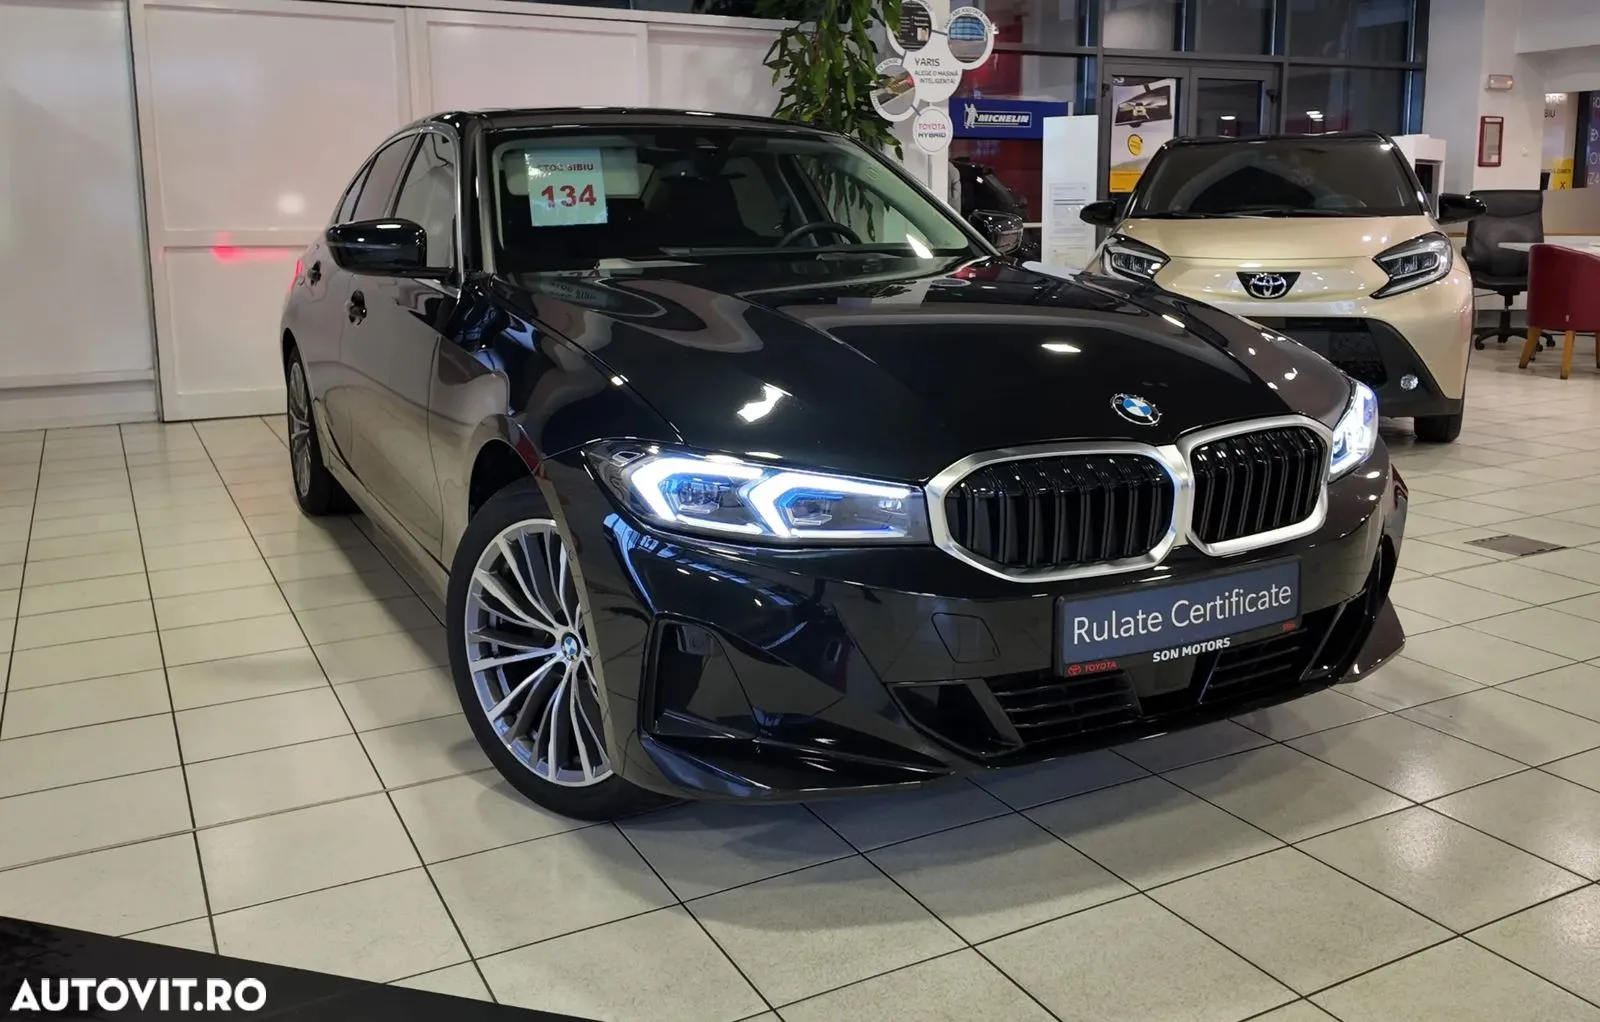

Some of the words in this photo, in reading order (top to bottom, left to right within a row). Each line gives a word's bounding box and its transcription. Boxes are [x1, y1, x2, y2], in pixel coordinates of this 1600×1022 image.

[914, 57, 940, 66] YARIS
[977, 114, 1030, 123] MICHELIN
[567, 163, 594, 171] SIBIU
[541, 184, 598, 208] 134
[1073, 611, 1164, 645] Rulate
[1171, 584, 1292, 627] Certificate
[1152, 648, 1180, 662] SON
[1181, 637, 1231, 657] MOTORS
[1085, 661, 1117, 672] TOYOTA
